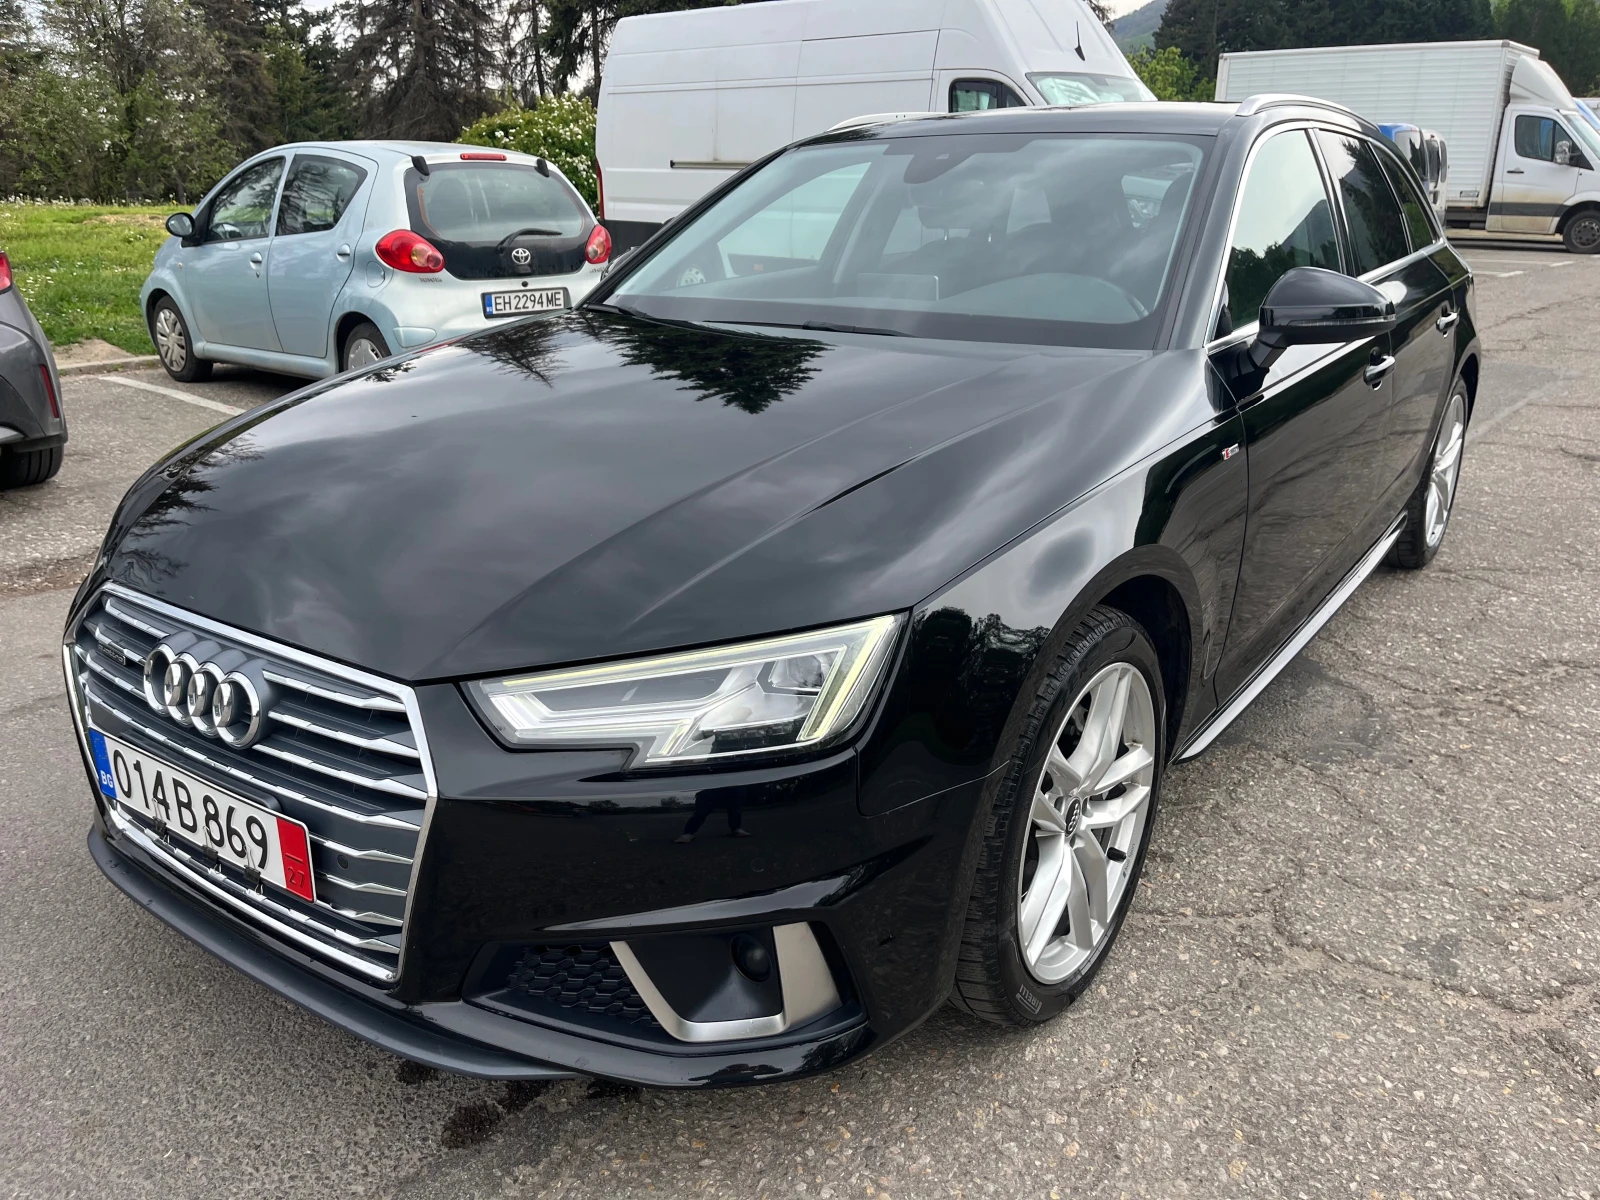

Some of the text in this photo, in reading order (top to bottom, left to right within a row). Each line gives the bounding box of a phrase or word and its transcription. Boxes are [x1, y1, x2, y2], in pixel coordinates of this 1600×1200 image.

[494, 291, 562, 311] EH 2294 ME
[100, 769, 114, 789] BG
[288, 866, 304, 889] 27
